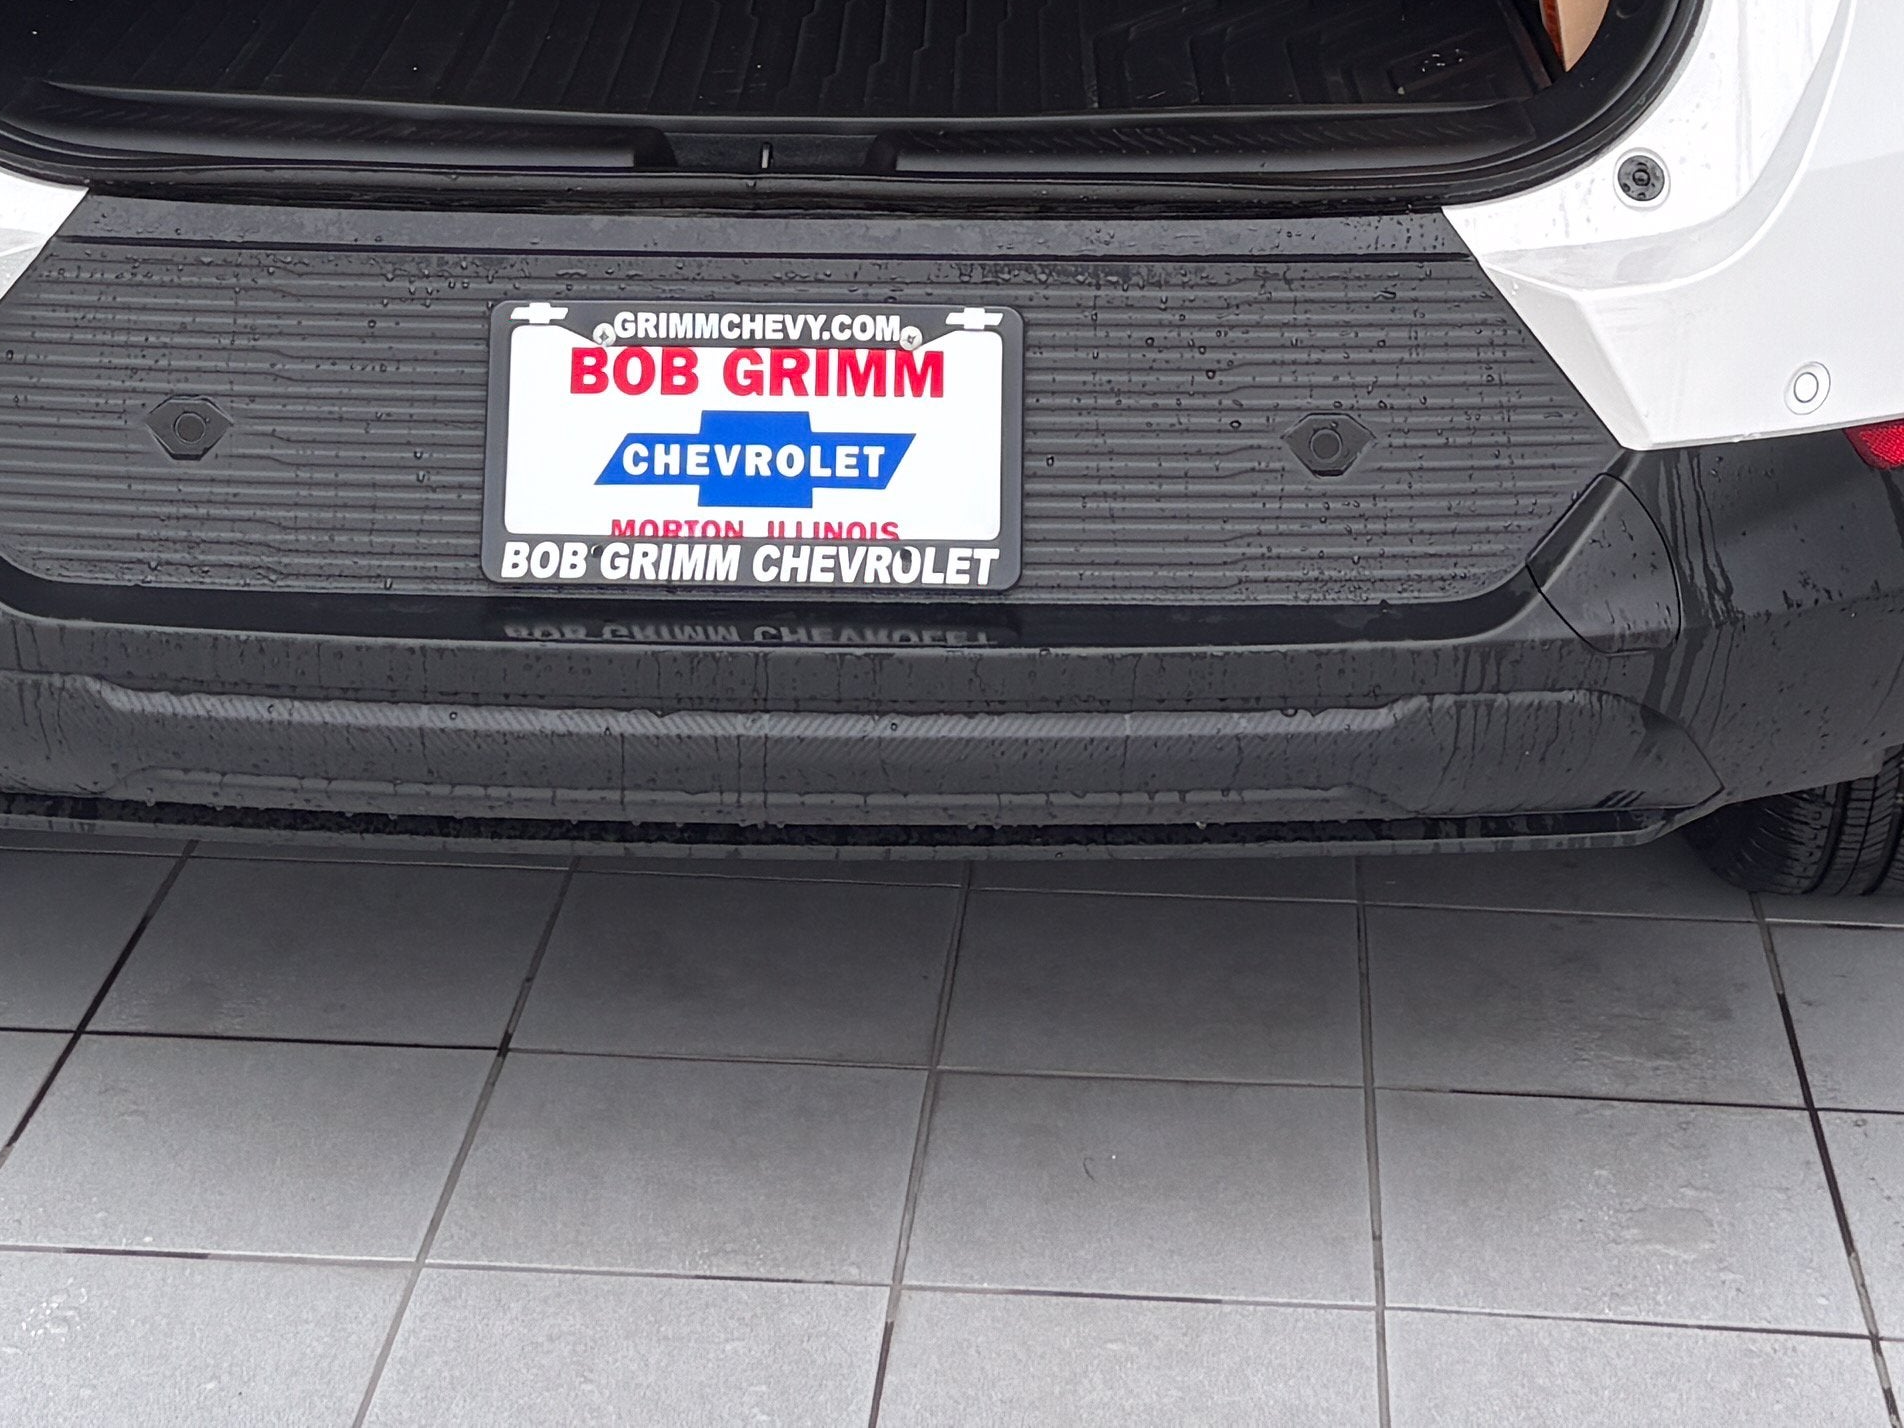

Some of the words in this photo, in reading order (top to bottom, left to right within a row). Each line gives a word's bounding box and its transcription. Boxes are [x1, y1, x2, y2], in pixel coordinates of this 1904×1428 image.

[614, 311, 901, 342] GRIMMCHEVY.COM
[570, 346, 698, 396] BOB
[723, 347, 944, 398] GRIMM
[622, 443, 886, 478] CHEVROLET
[610, 519, 744, 538] MORTON
[501, 542, 588, 580] BOB
[600, 542, 740, 582] GRIMM
[752, 545, 1000, 586] CHEVROLET
